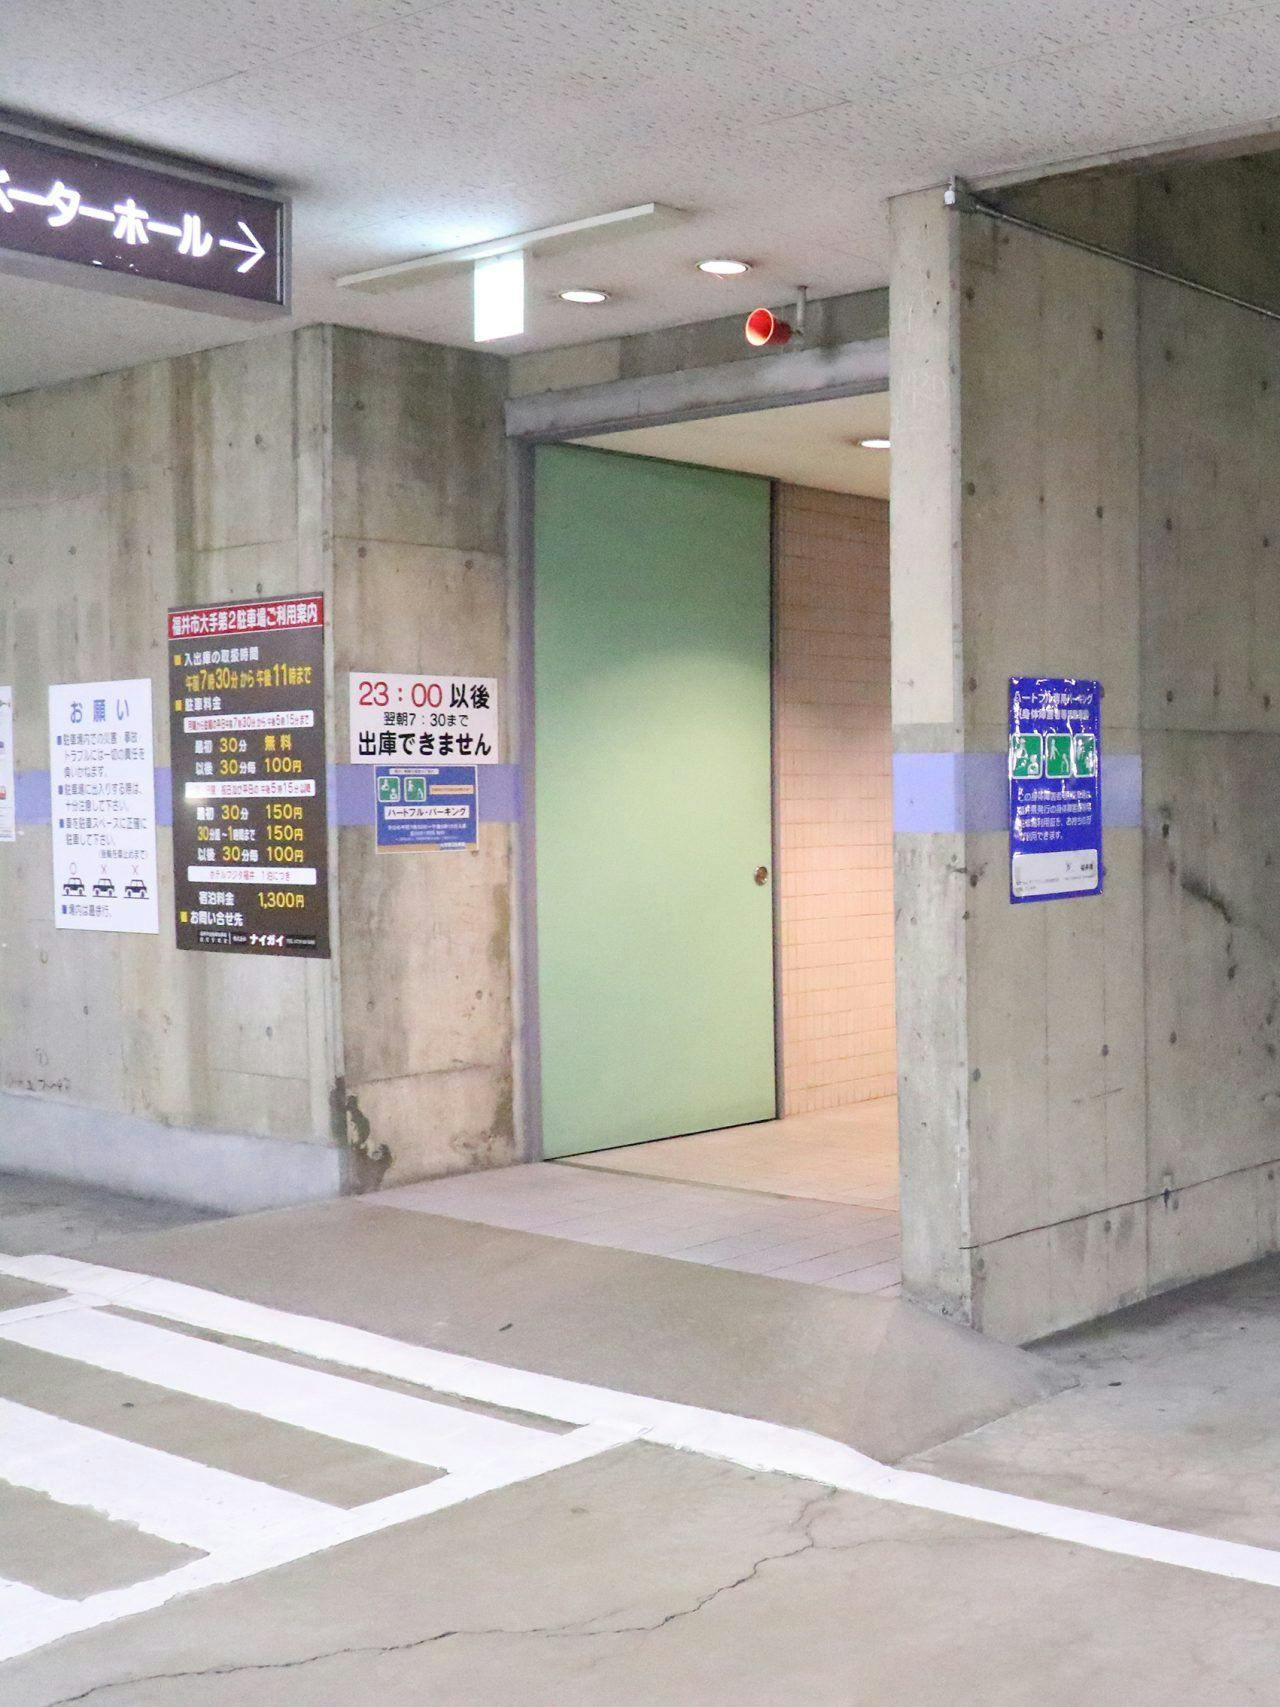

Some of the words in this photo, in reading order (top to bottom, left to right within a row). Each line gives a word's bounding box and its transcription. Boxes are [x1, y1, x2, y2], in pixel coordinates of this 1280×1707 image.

[172, 603, 318, 636] 福井市大手第2駐車場ご利用案内
[184, 646, 259, 666] 入出庫の取扱時間
[70, 699, 130, 724] お願い
[184, 696, 222, 712] 駐車料金
[219, 737, 247, 753] 30分
[358, 731, 491, 756] 出庫できません
[265, 757, 302, 773] 100円
[221, 804, 249, 820] 30分
[265, 803, 303, 820] 150円
[266, 825, 304, 841] 150円
[267, 846, 304, 862] 100円
[198, 891, 235, 907] 宿泊料金
[258, 891, 305, 908] 1,300円
[190, 910, 244, 927] お問い合せ先
[249, 933, 285, 947] ナイガイ
